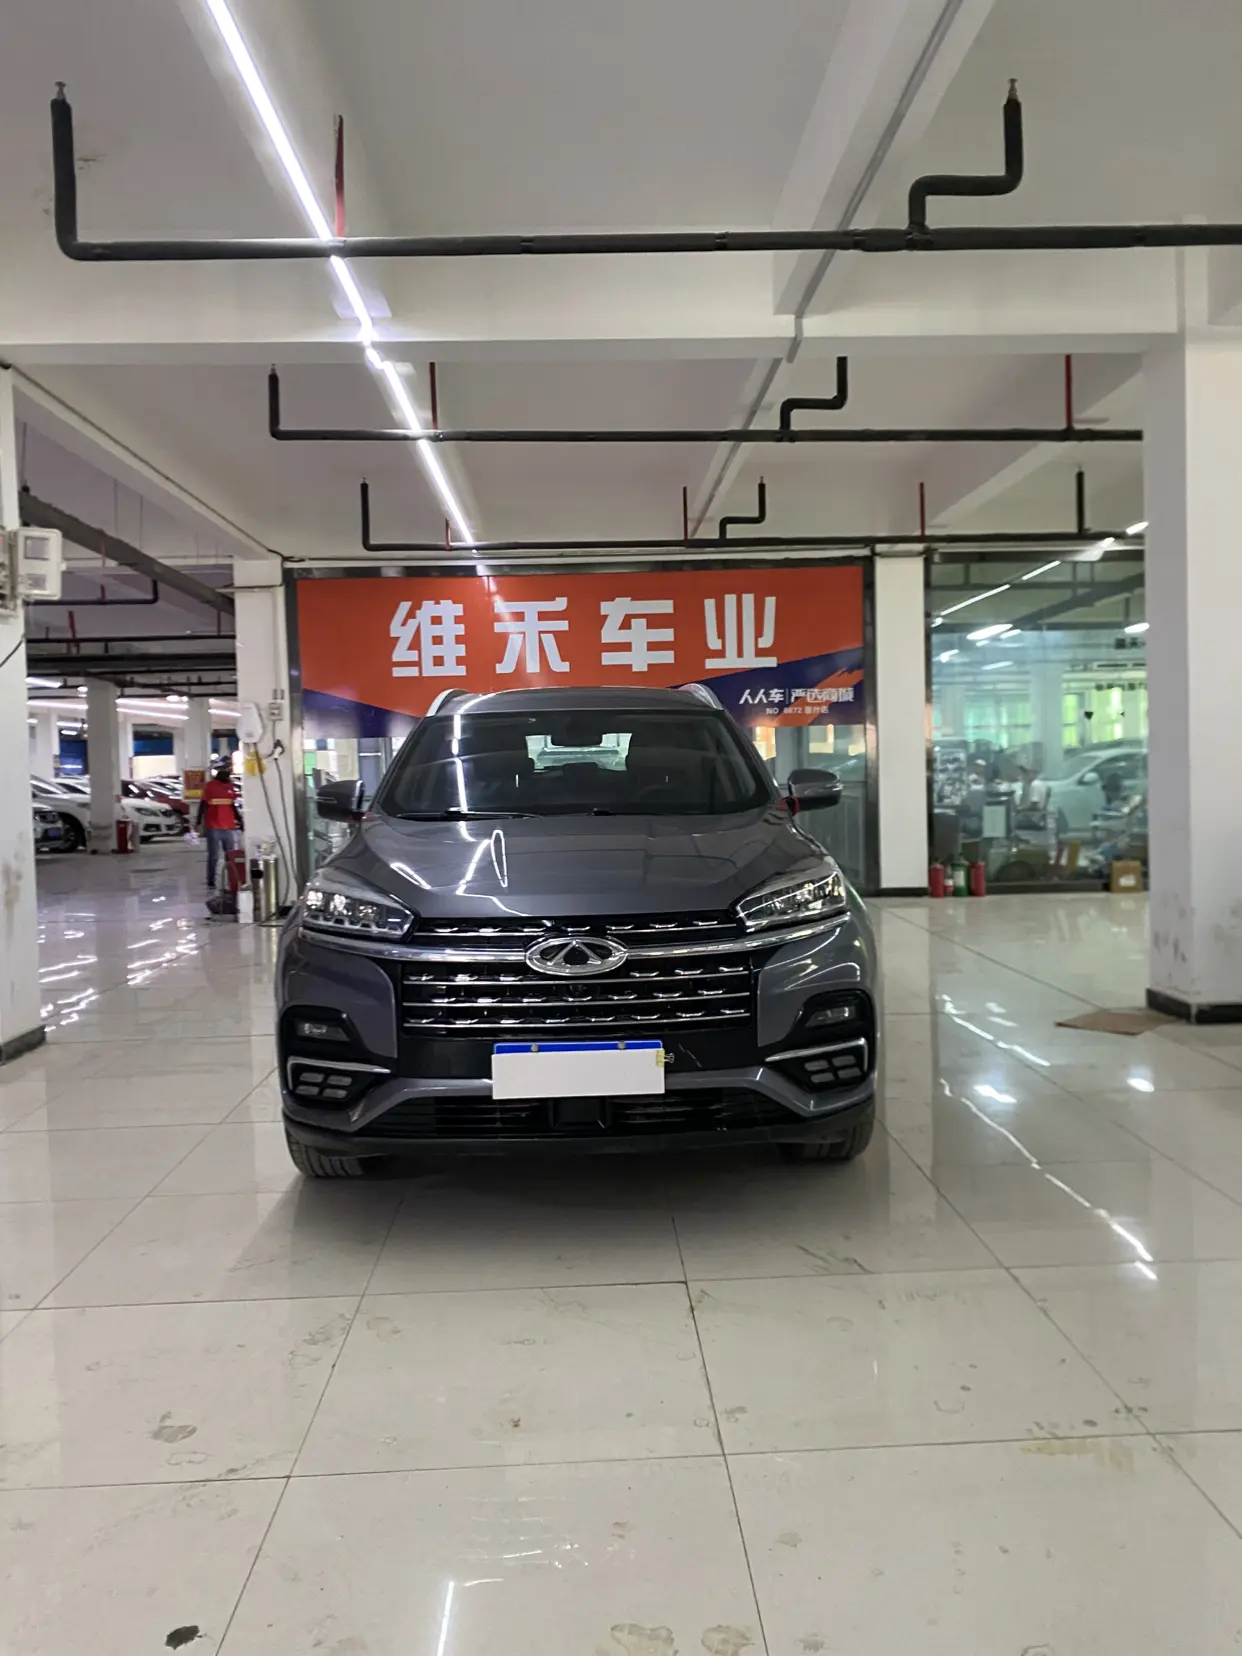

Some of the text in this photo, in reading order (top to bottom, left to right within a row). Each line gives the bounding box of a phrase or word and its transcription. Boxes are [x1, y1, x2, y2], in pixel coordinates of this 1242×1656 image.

[390, 593, 778, 677] 维禾车业
[739, 688, 784, 704] 人人车
